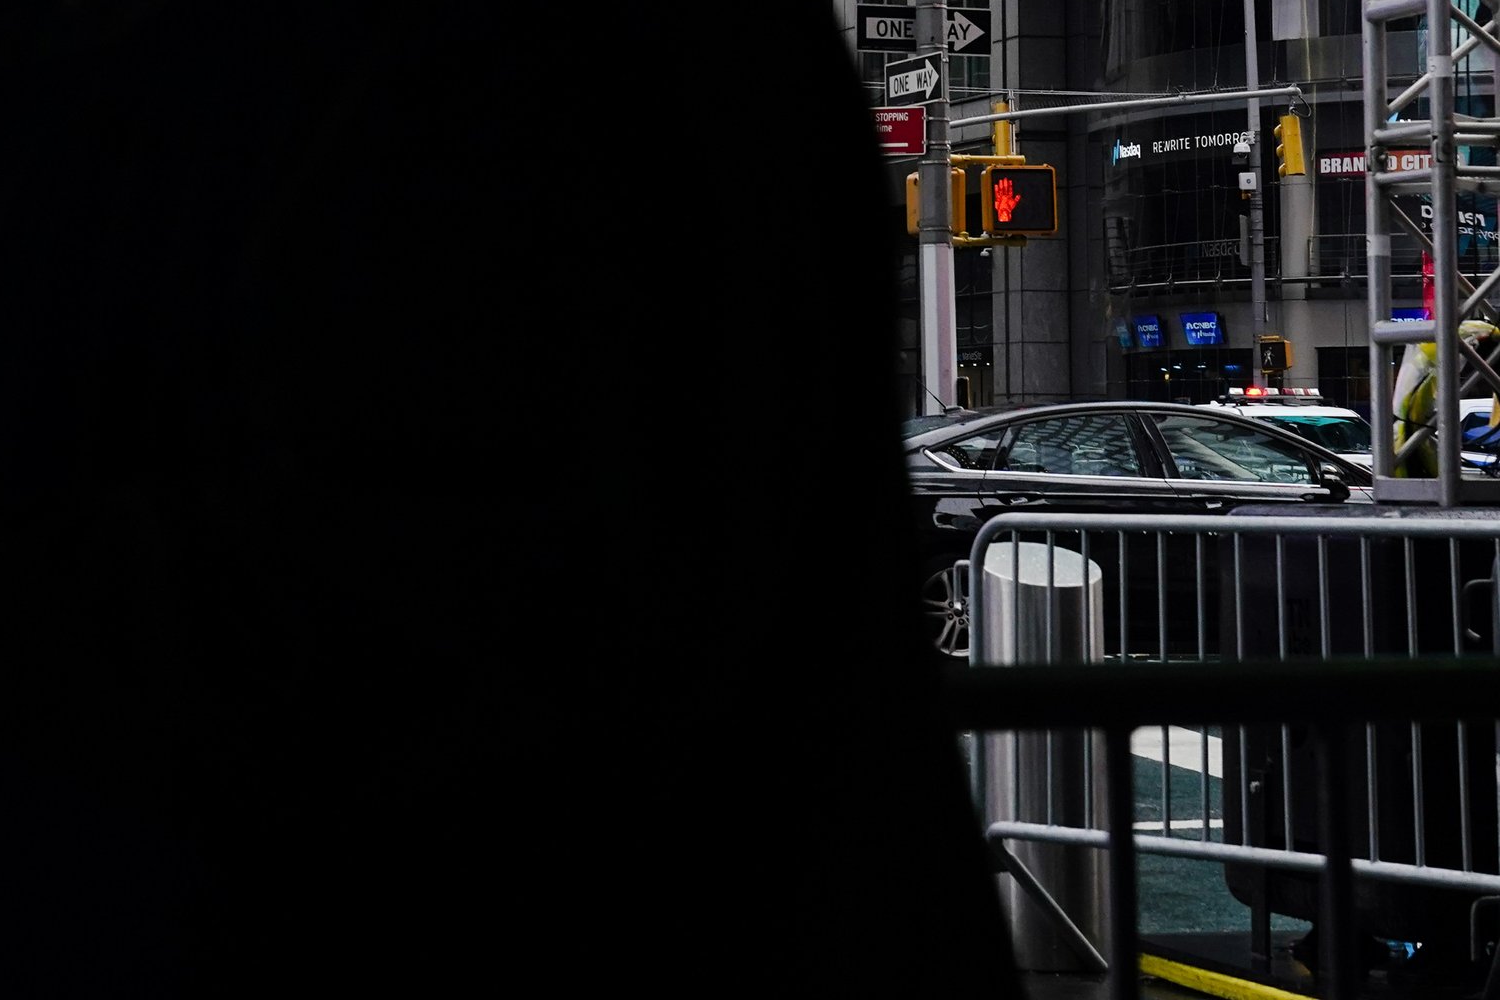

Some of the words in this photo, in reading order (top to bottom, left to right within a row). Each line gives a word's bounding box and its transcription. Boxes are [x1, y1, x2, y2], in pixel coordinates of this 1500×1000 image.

[876, 20, 914, 38] ONE
[947, 23, 971, 41] AY
[893, 75, 910, 95] ONE
[916, 70, 934, 89] WAY
[875, 112, 909, 122] STOPPING
[877, 123, 892, 132] time
[1119, 142, 1141, 159] Nasdaq
[1153, 137, 1191, 153] REWRITE
[1194, 131, 1248, 148] TOMORRO
[1192, 321, 1216, 329] CNBC
